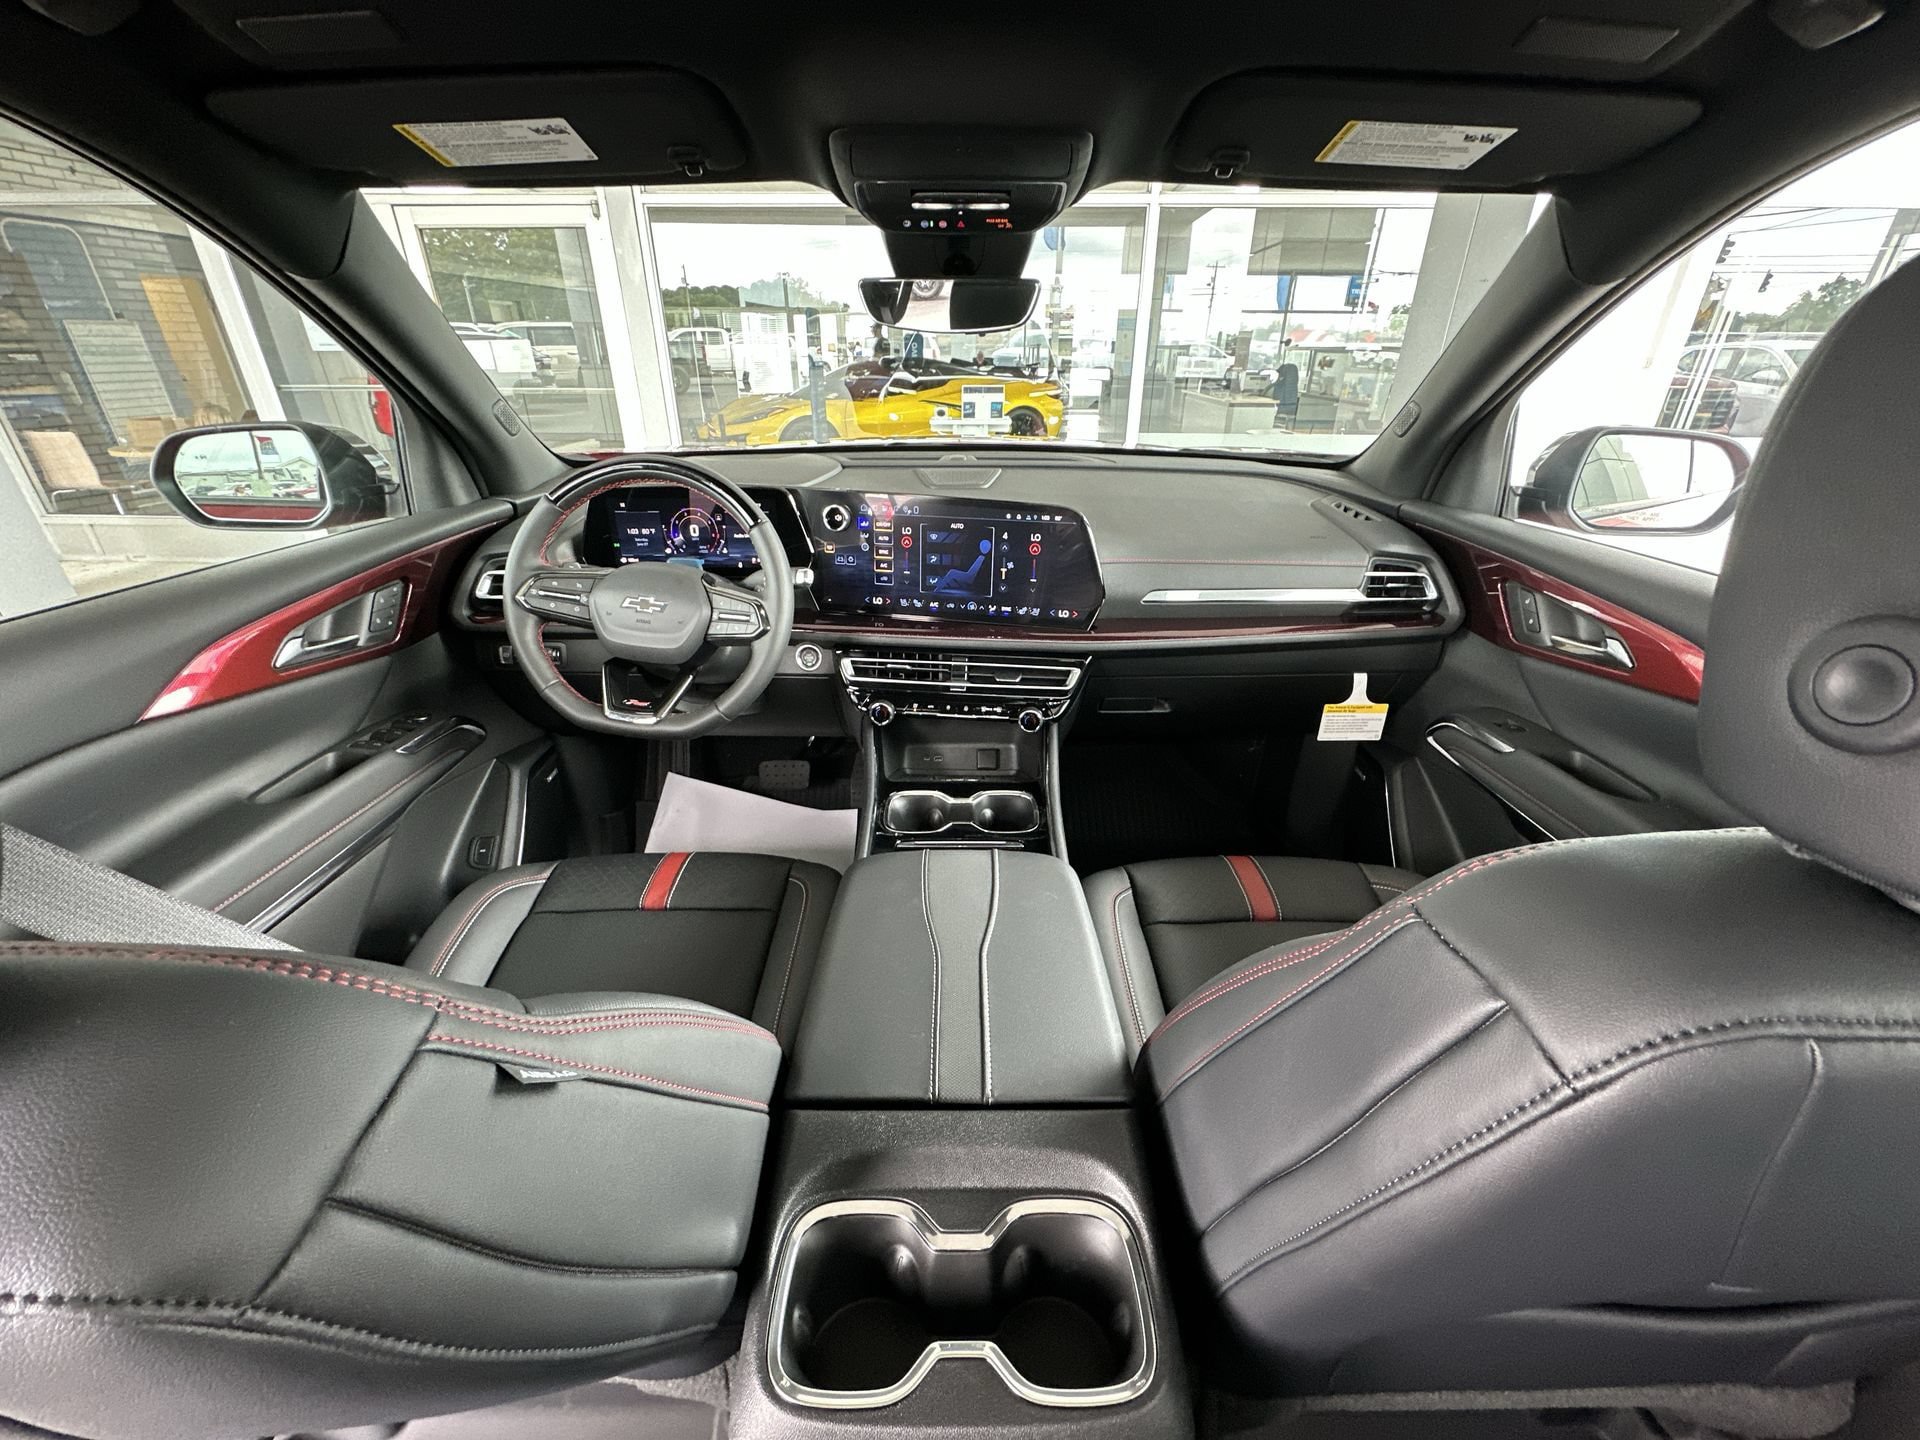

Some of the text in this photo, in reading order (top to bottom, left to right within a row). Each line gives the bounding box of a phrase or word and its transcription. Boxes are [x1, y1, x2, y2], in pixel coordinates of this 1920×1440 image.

[901, 526, 912, 535] LO
[1002, 531, 1009, 540] 4
[1030, 533, 1042, 542] LO
[872, 597, 883, 605] LO
[1058, 609, 1070, 618] LO
